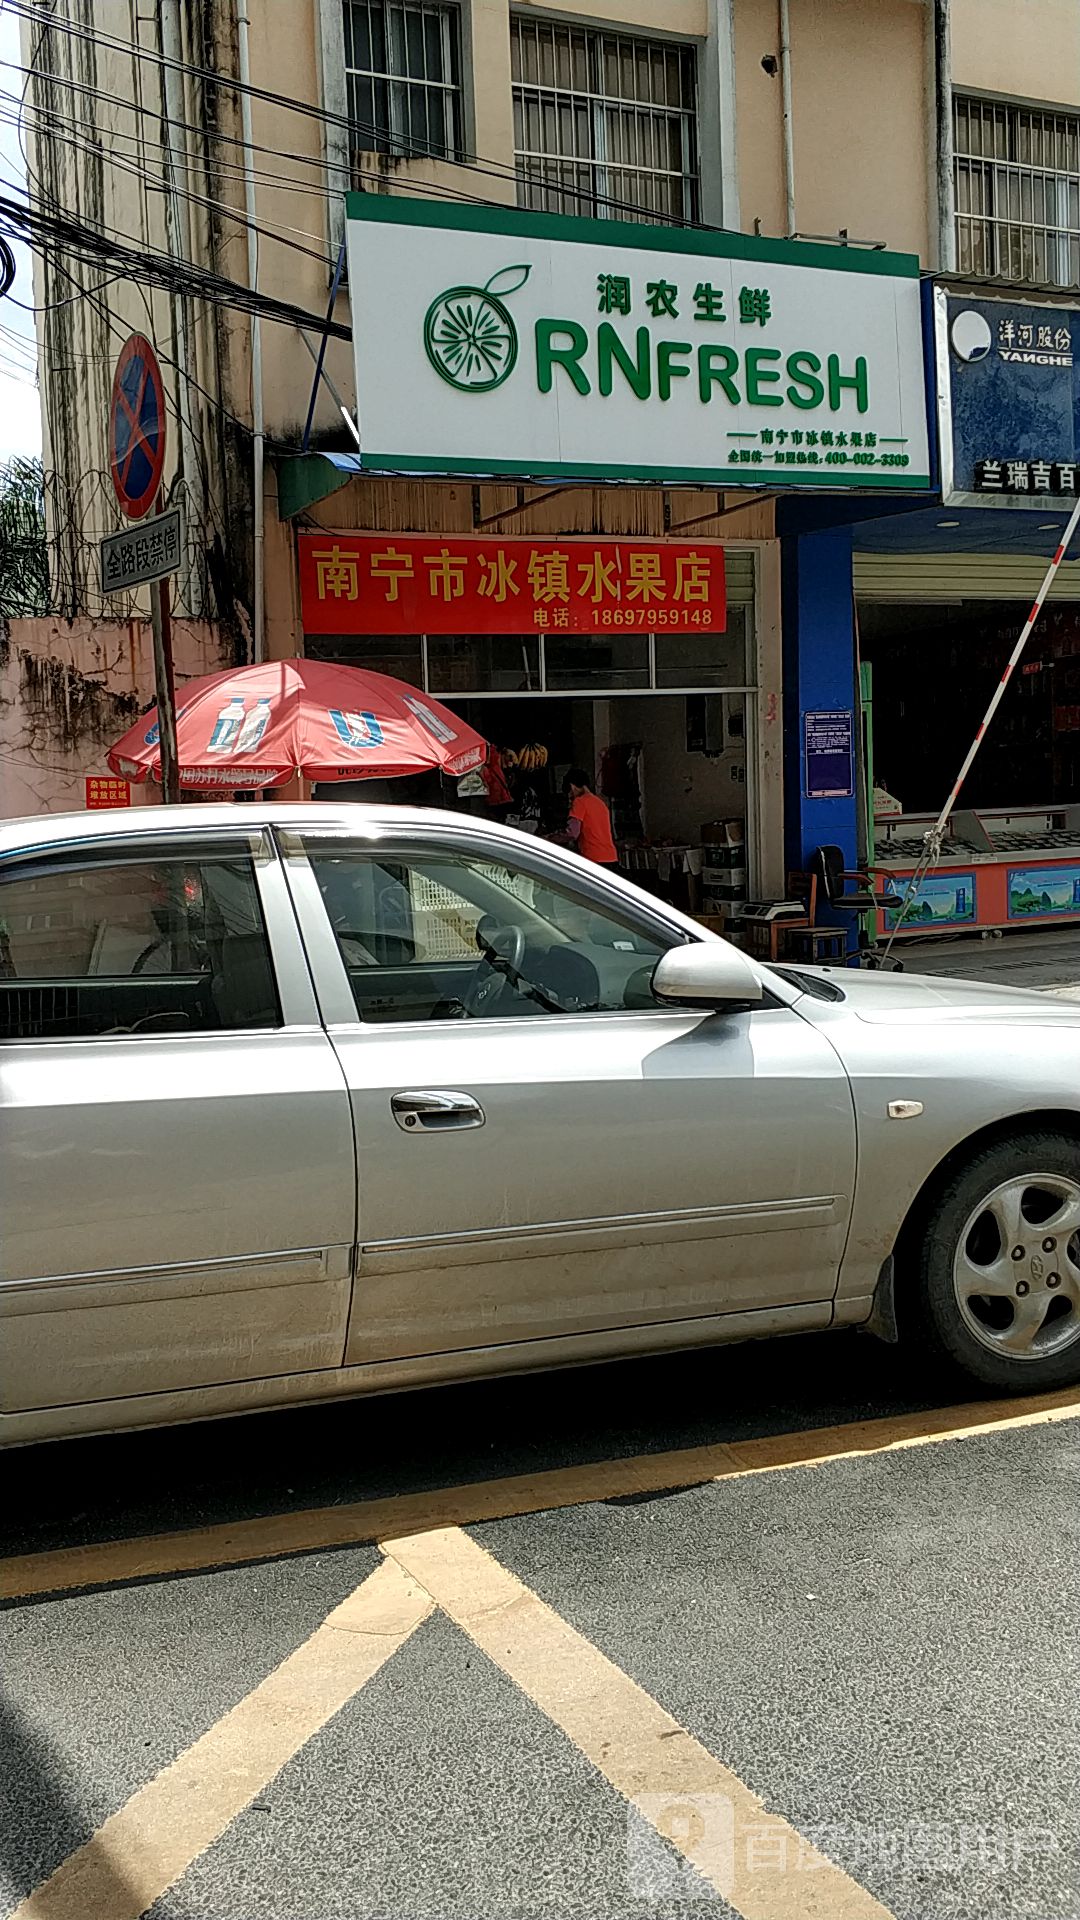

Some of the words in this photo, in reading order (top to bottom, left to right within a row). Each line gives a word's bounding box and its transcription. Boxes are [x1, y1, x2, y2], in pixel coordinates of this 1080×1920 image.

[597, 273, 772, 326] 润农生鲜
[998, 320, 1072, 350] 洋河股份
[534, 317, 869, 414] RNFRESH
[998, 351, 1073, 366] YANGHE
[760, 428, 877, 447] 南宁市冰镇水果店
[981, 460, 1077, 490] 兰瑞吉百
[107, 526, 177, 580] 全路段禁停
[312, 545, 711, 603] 南宁市冰镇水果店
